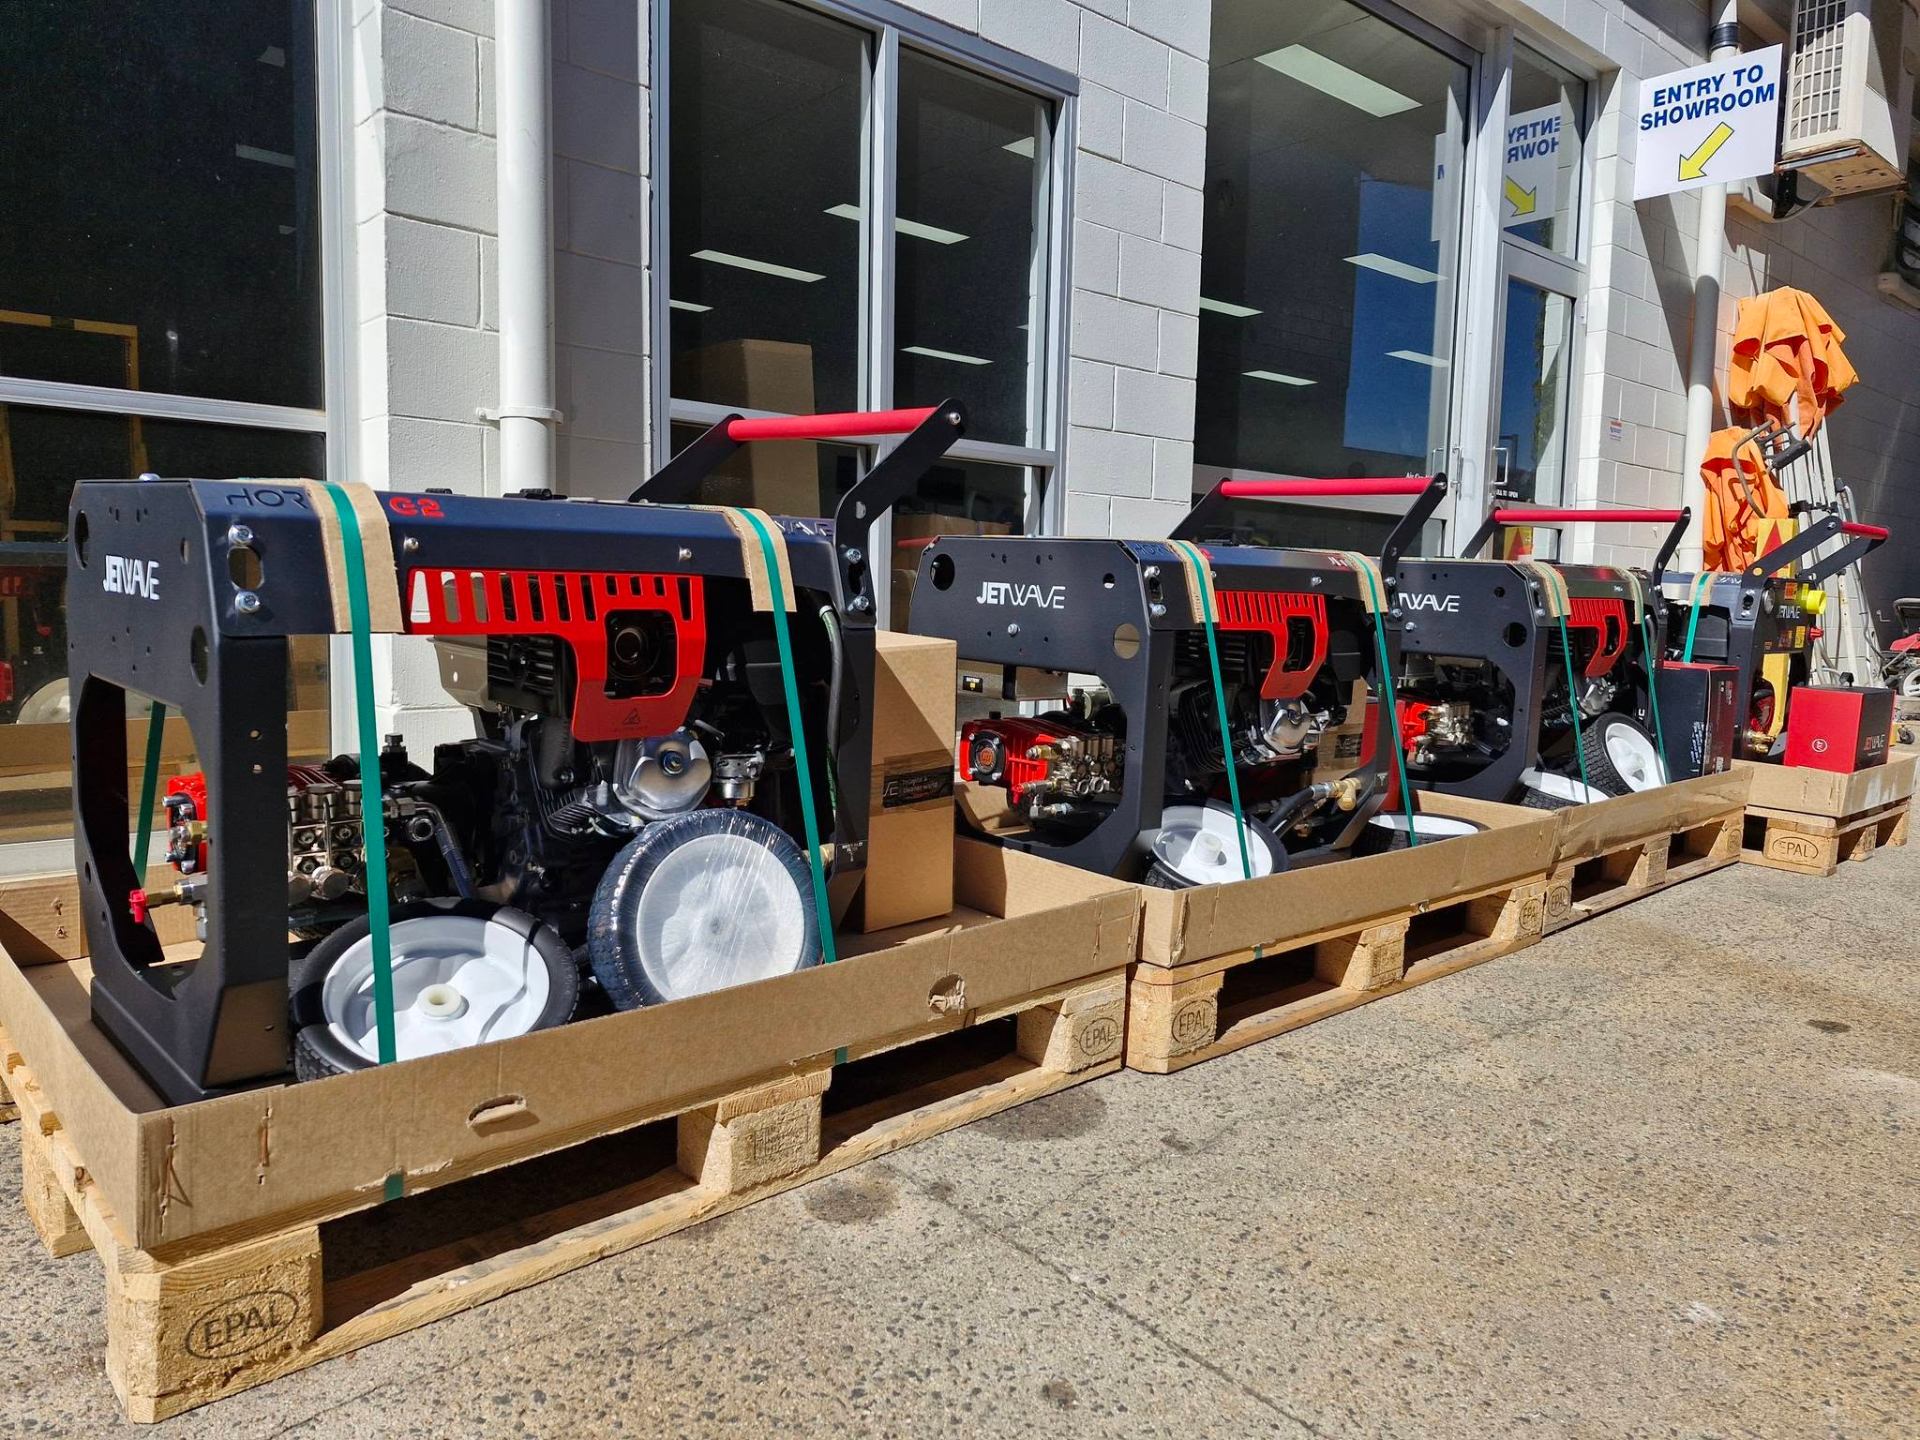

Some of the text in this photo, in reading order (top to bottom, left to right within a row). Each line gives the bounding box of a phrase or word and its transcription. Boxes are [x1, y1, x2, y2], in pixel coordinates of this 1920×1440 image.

[1653, 64, 1763, 107] ENTRY TO
[1640, 83, 1775, 131] SHOWROOM
[388, 496, 445, 518] G2
[103, 554, 160, 601] JETWAVE
[976, 581, 1066, 609] JETWAVE
[1085, 1026, 1114, 1049] EPAL
[1178, 1007, 1209, 1038] EPAL
[204, 1300, 285, 1351] EPAL
